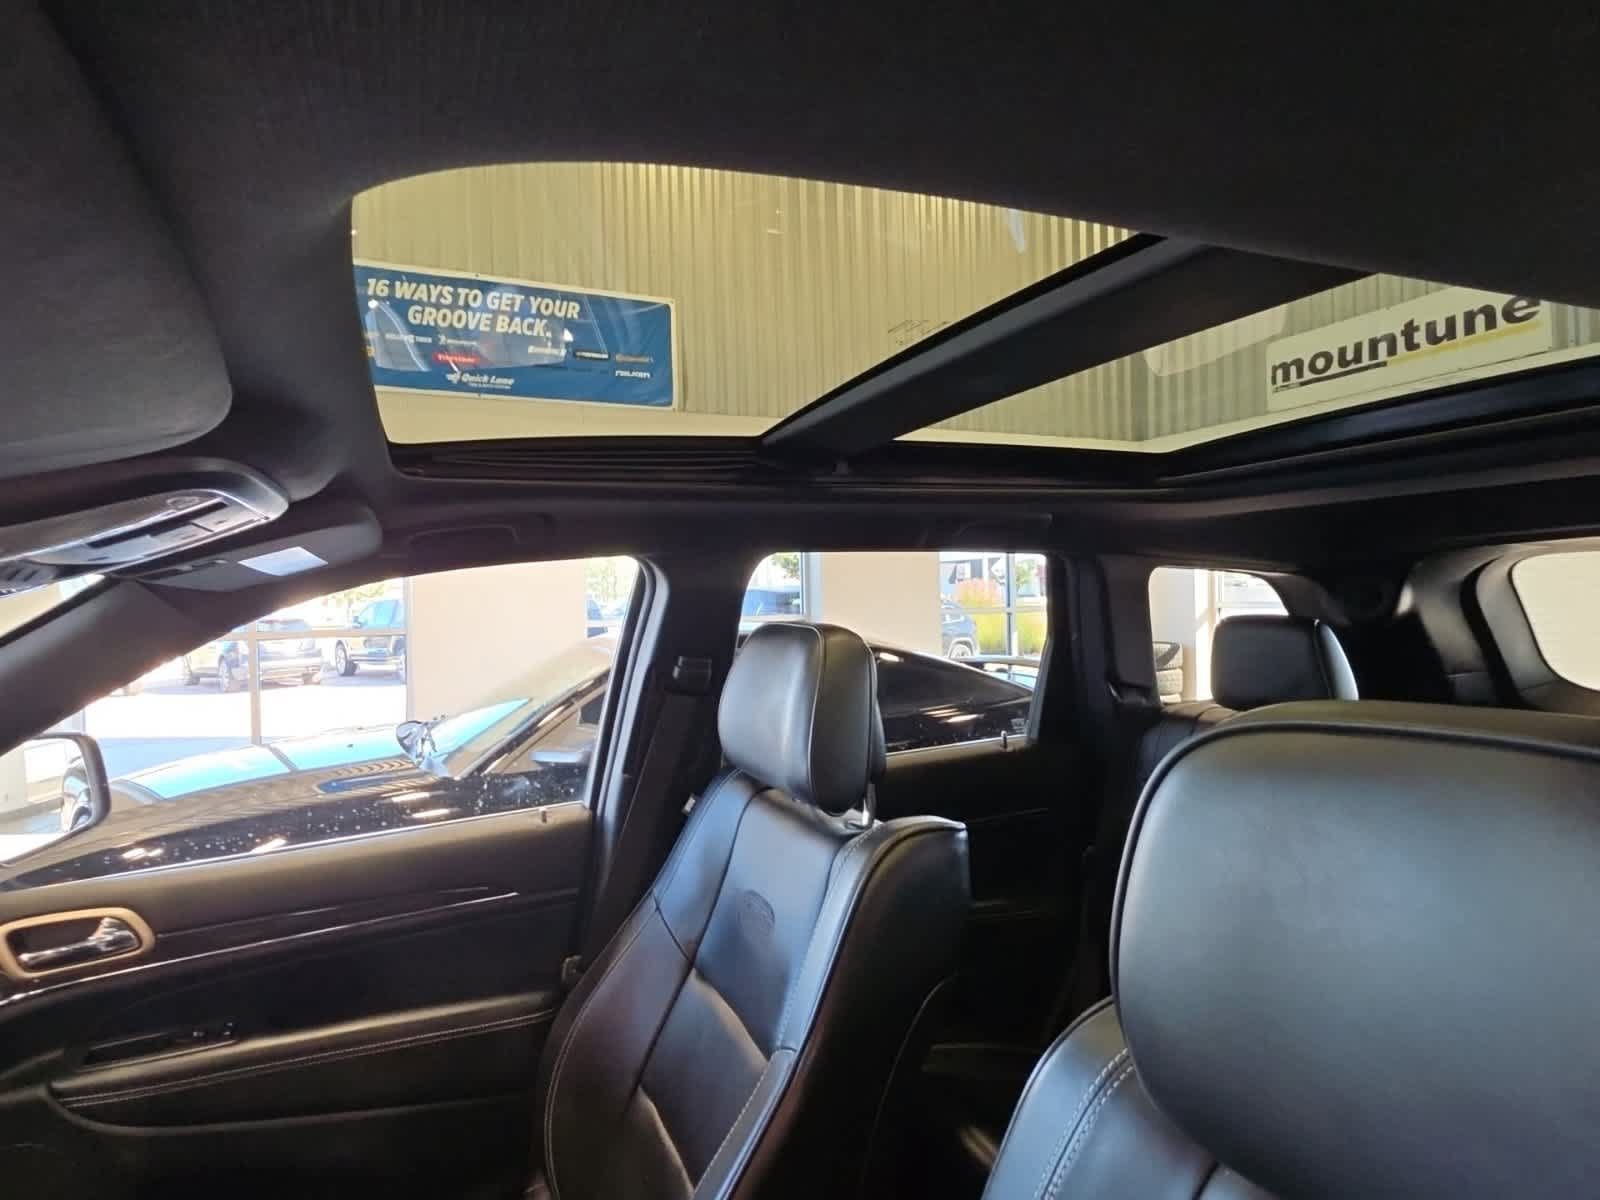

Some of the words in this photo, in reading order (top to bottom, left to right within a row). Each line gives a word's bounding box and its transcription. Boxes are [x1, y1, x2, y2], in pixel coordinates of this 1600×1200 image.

[367, 278, 389, 297] 16
[394, 281, 454, 303] WAYS
[456, 287, 482, 308] TO
[486, 291, 525, 313] GET
[529, 297, 580, 319] YOUR
[407, 305, 492, 333] GROOVE
[496, 314, 552, 338] BACK.
[1271, 295, 1541, 386] mountune
[461, 372, 489, 384] Quick
